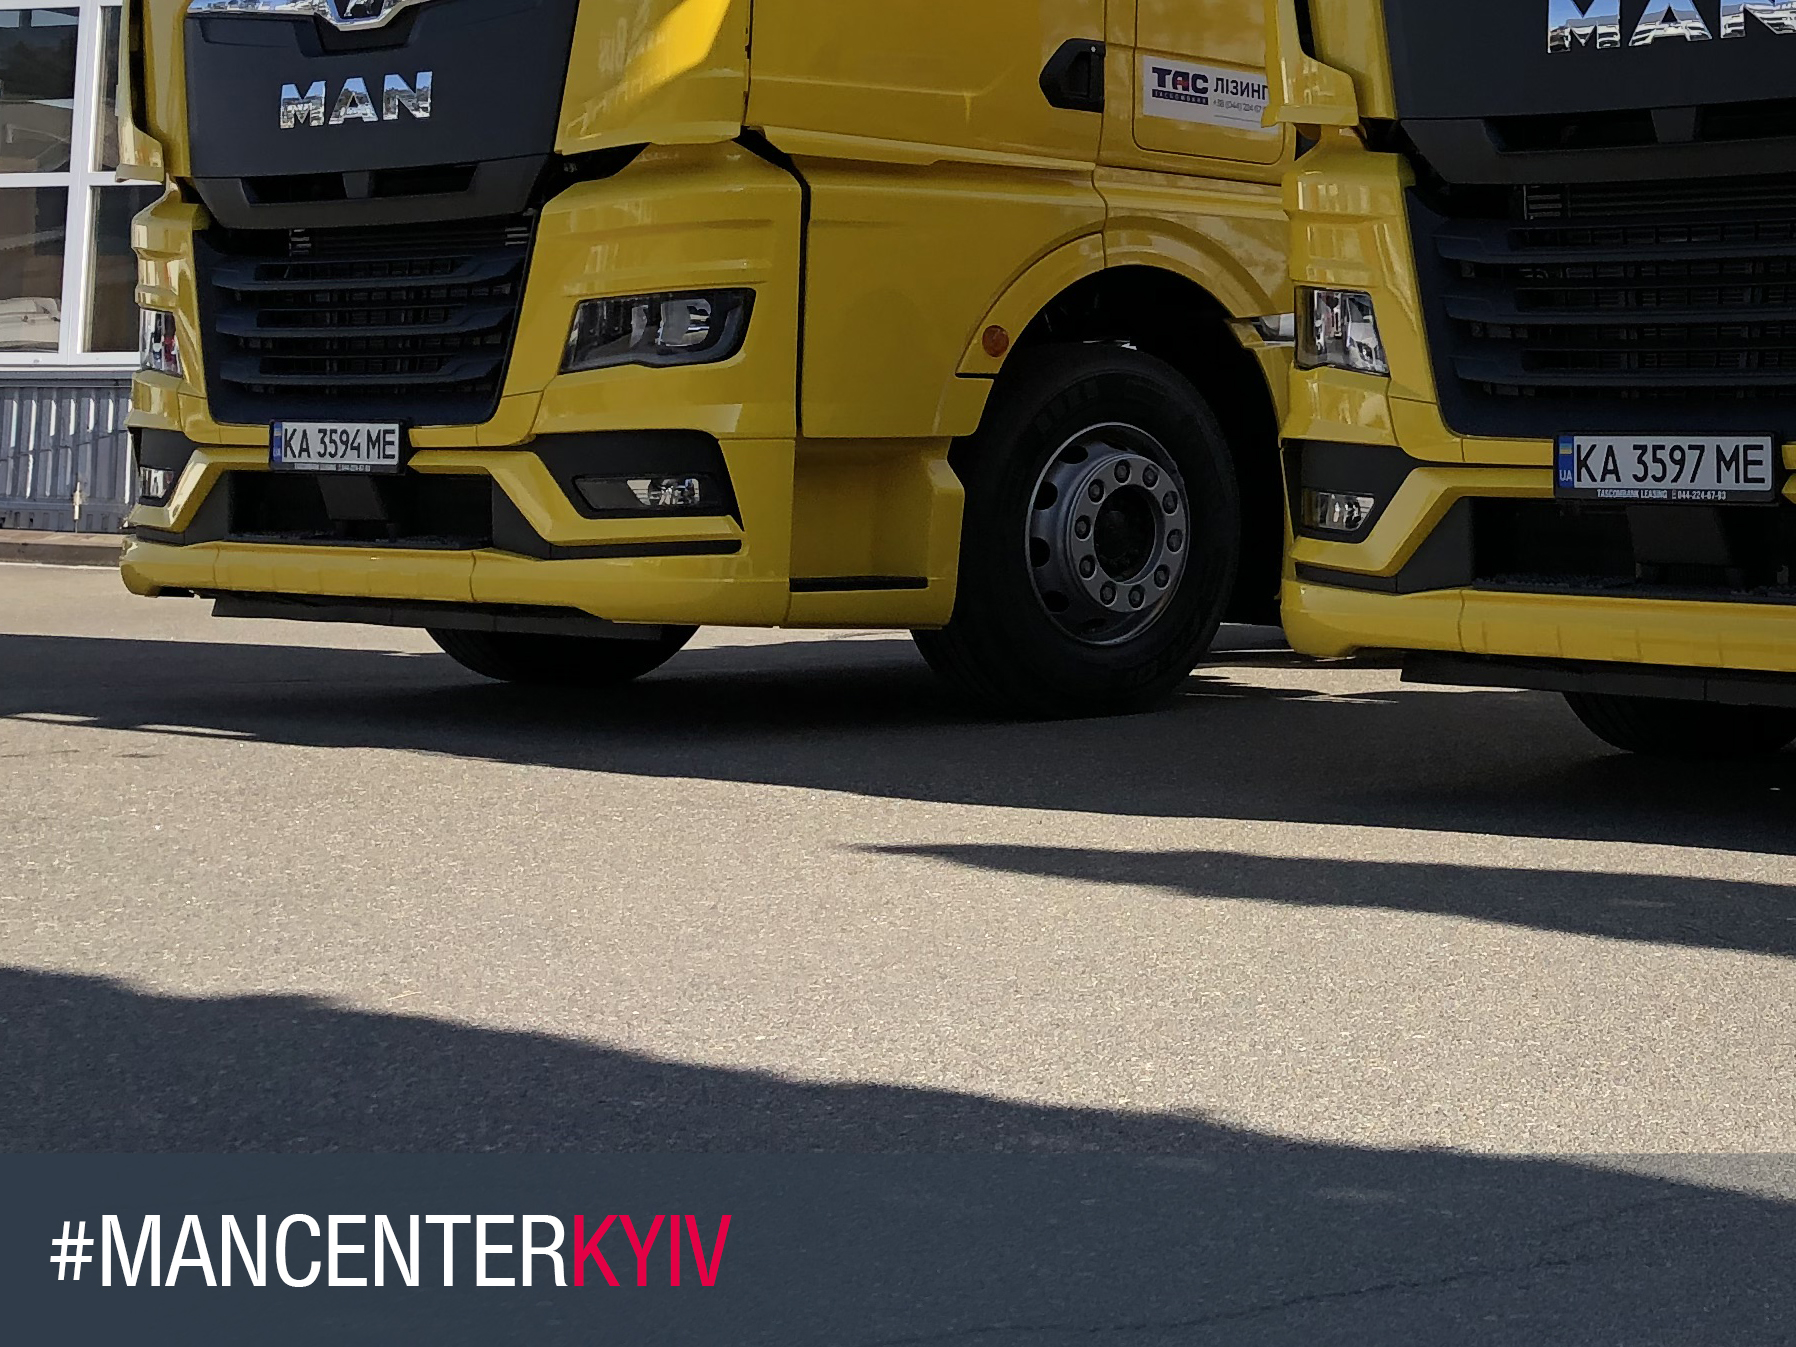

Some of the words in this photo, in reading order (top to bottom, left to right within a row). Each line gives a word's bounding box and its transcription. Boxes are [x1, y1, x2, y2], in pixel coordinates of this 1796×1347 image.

[280, 70, 433, 129] MAN
[1213, 77, 1269, 101] ЛІЗИНГ
[283, 428, 311, 458] KA
[317, 428, 361, 459] 3594
[366, 428, 396, 459] ME
[1559, 469, 1573, 482] UA
[1576, 444, 1621, 483] KA
[1632, 444, 1705, 483] 3597
[1715, 444, 1766, 484] ME
[1640, 489, 1668, 500] LEASING
